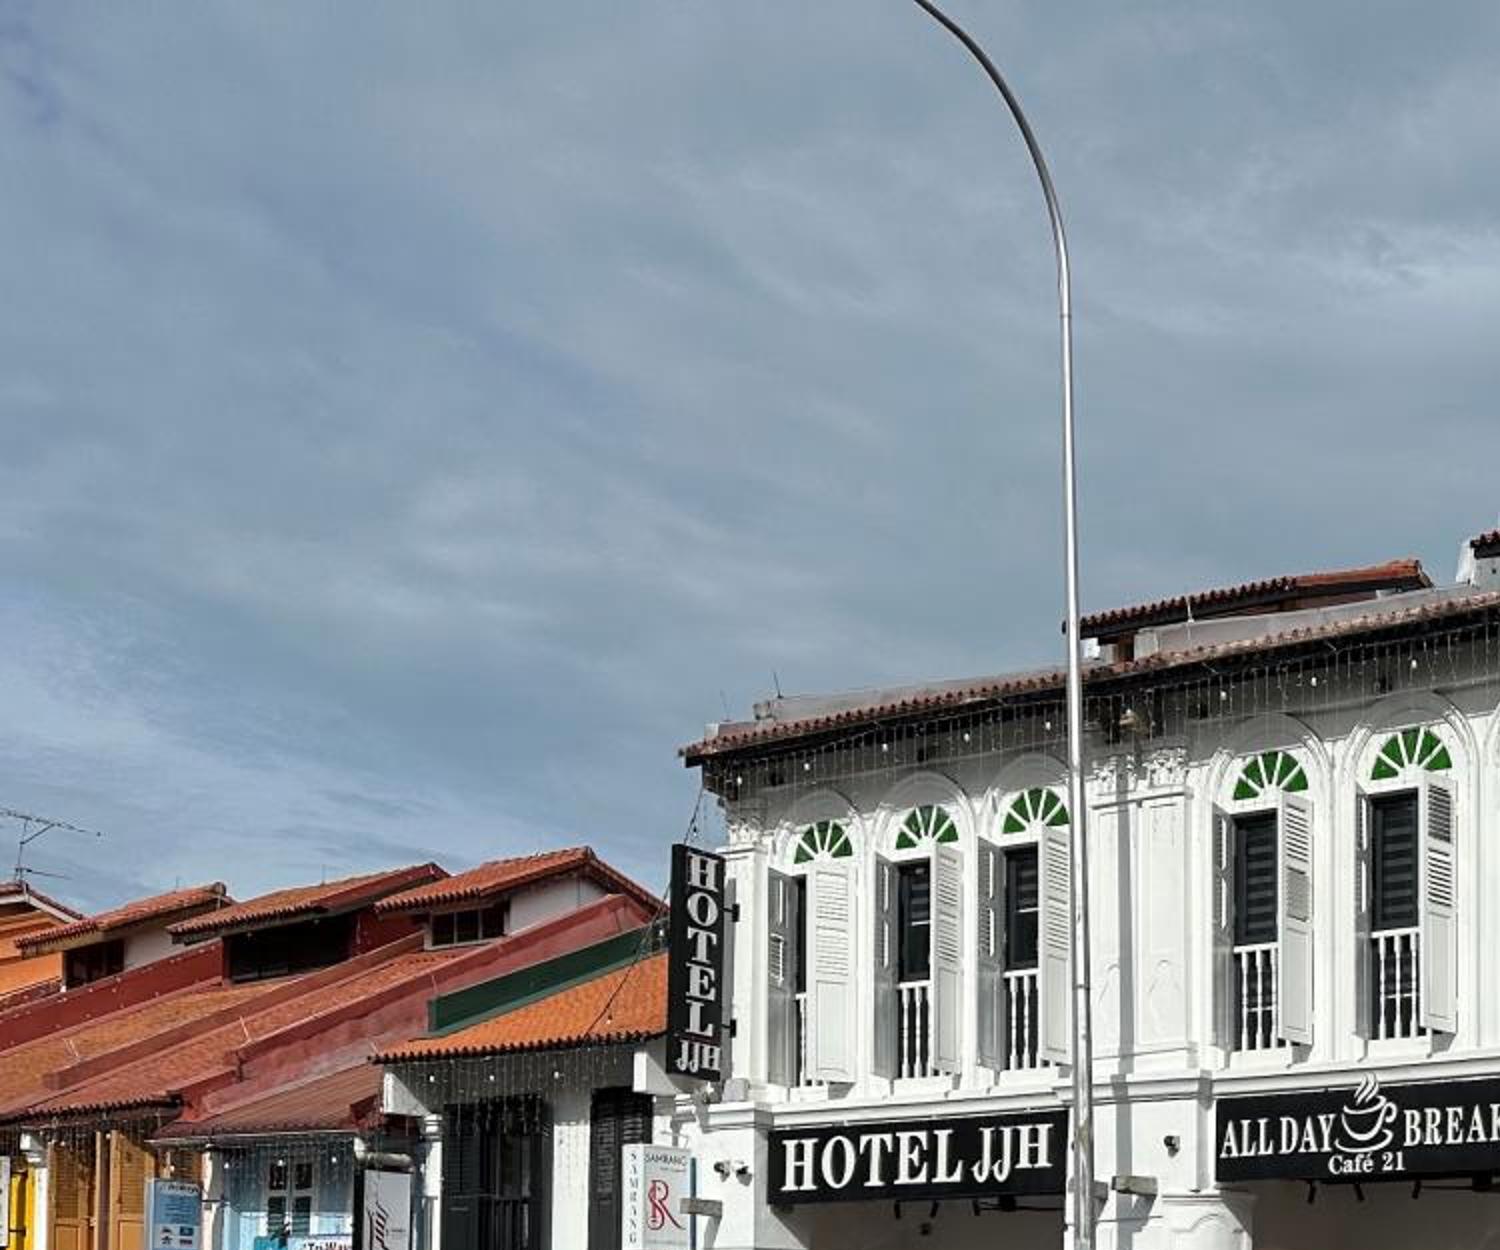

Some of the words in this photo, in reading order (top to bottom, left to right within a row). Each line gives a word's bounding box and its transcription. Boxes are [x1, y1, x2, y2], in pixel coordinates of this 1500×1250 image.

[685, 851, 719, 1037] HOTEL
[675, 1040, 721, 1073] JJH
[780, 1128, 963, 1192] HOTEL
[970, 1123, 1054, 1184] JJH
[1219, 1119, 1274, 1159] ALL
[1279, 1113, 1336, 1155] DAY
[1327, 1151, 1375, 1175] Café
[1381, 1151, 1406, 1172] 21
